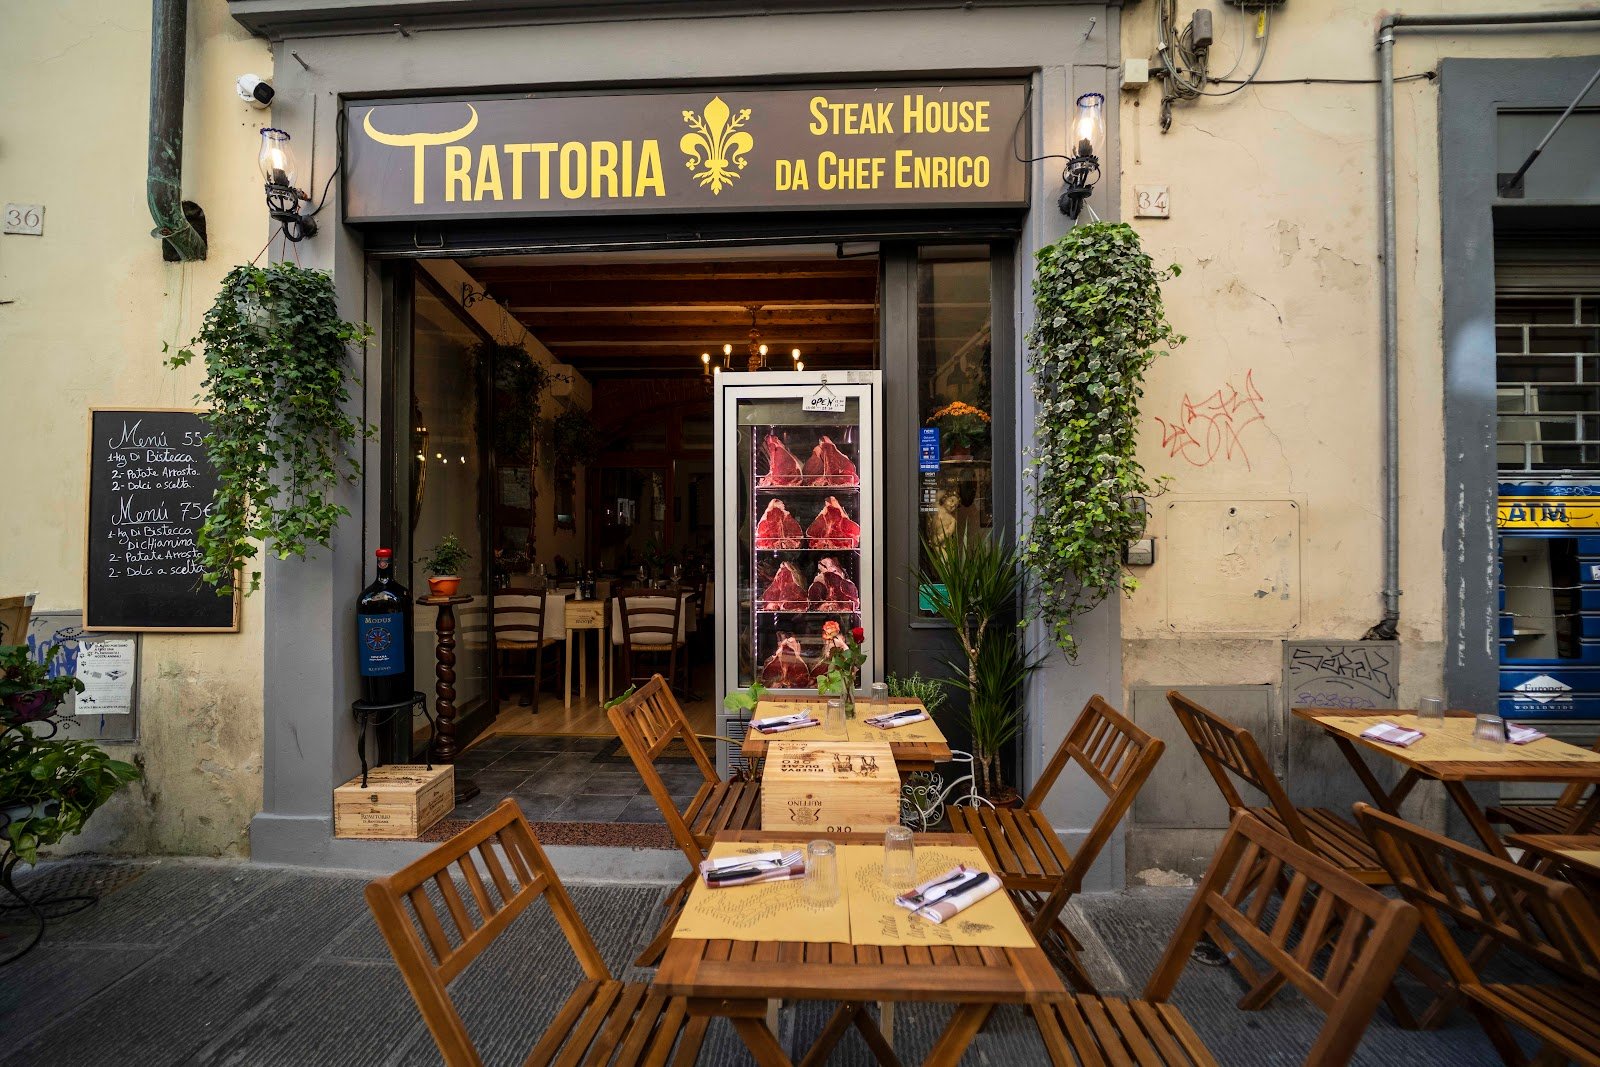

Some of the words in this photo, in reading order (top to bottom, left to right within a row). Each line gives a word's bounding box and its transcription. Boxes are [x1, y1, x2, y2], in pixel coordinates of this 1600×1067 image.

[809, 96, 894, 136] STEAK
[903, 94, 991, 134] HOUSE
[363, 104, 666, 204] TRATTORIA
[775, 159, 809, 191] DA
[817, 151, 886, 191] CHEF
[895, 150, 990, 189] ENRICO
[1138, 191, 1167, 213] 34
[7, 207, 40, 228] 36
[108, 419, 169, 450] Menú
[111, 494, 169, 526] Menú
[1508, 502, 1567, 522] ATM
[144, 524, 194, 537] Bistecca
[157, 567, 168, 575] a
